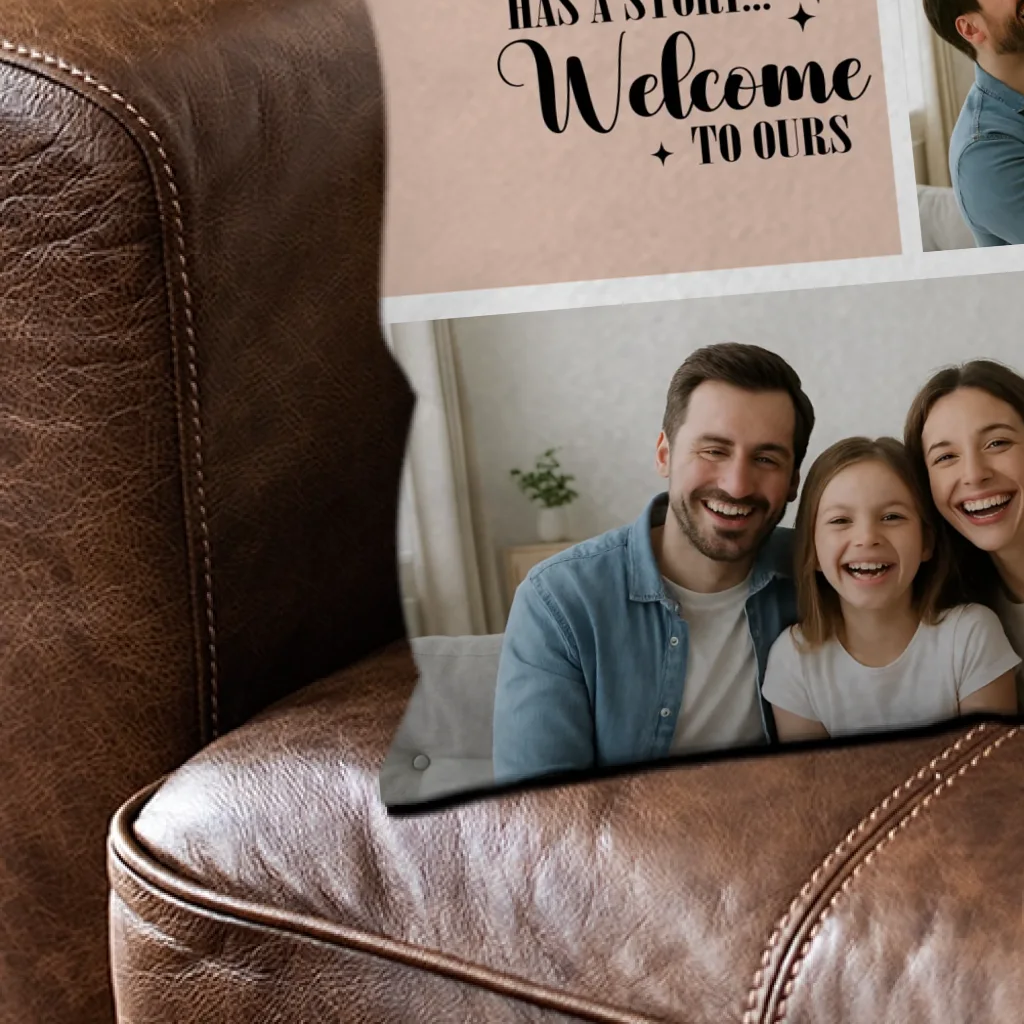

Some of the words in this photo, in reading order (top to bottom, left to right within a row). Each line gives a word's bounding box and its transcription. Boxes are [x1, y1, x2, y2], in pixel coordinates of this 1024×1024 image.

[497, 30, 872, 134] Welcome
[691, 124, 742, 165] TO
[753, 114, 852, 160] OURS
